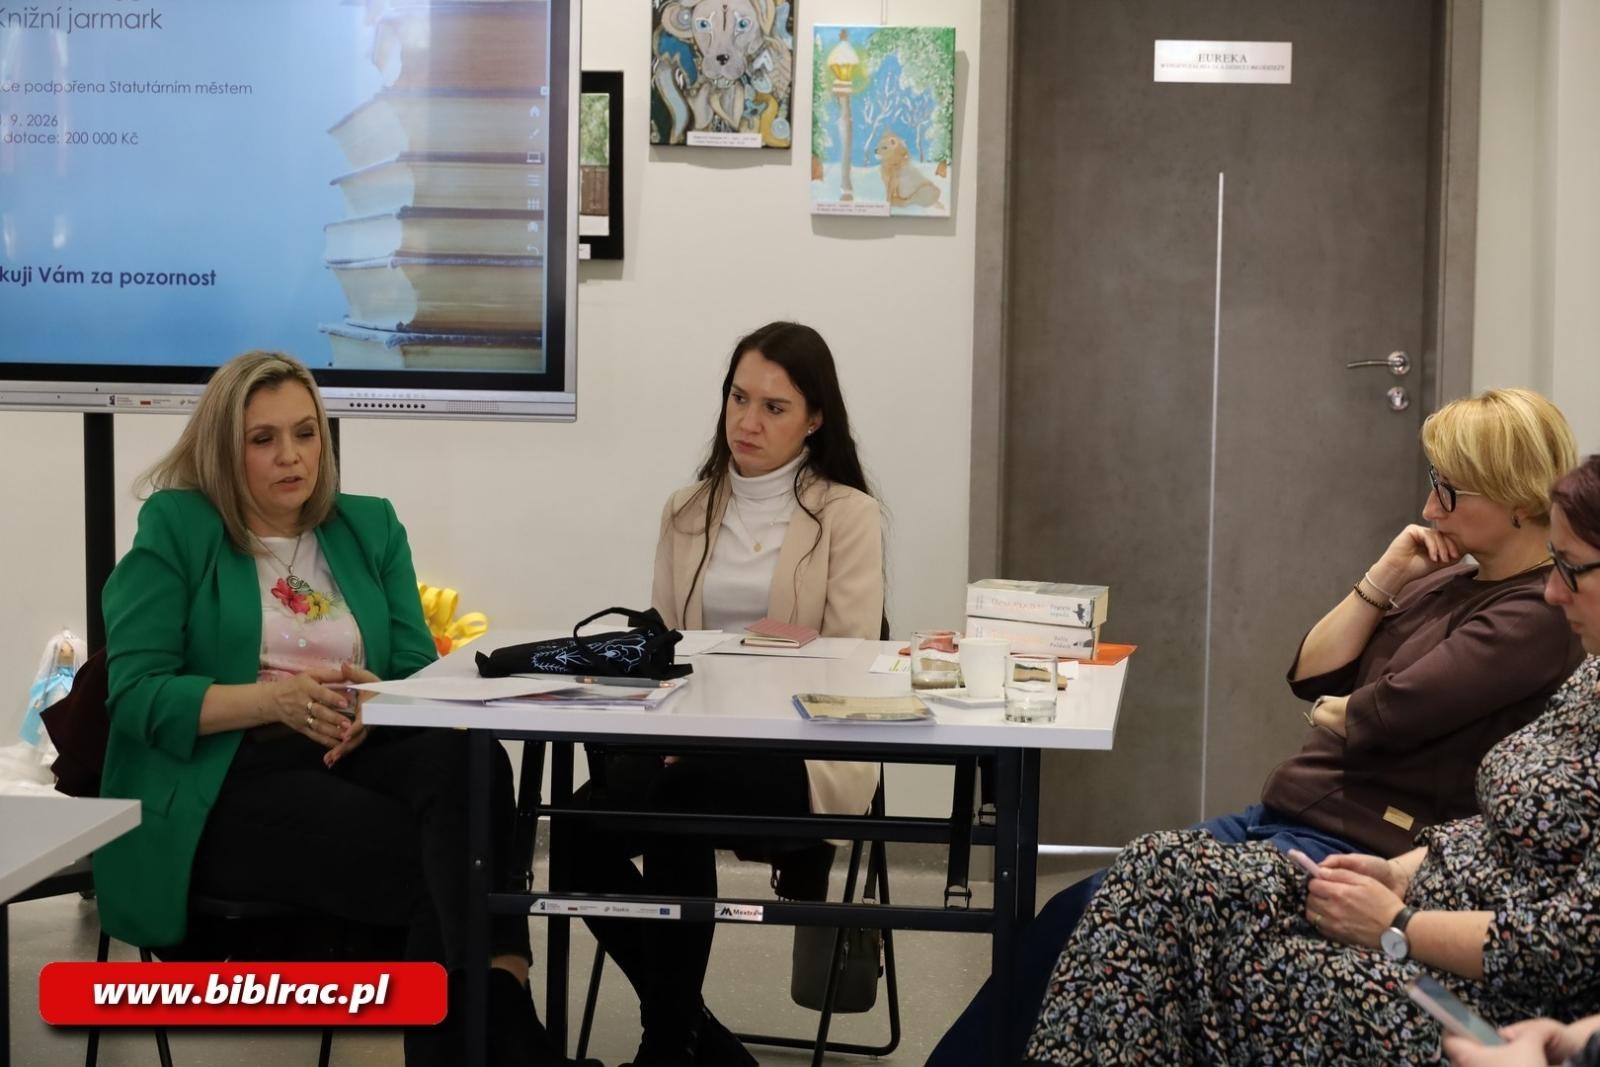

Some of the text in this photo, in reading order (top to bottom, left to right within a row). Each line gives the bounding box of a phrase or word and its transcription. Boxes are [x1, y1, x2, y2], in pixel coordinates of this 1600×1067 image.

[67, 8, 163, 34] jarmark
[1198, 53, 1248, 64] EUREKA
[24, 80, 106, 95] podpořena
[109, 80, 192, 94] Statutárním
[195, 81, 253, 95] městem
[26, 113, 59, 127] 2026
[3, 131, 139, 145] dotace: 200 000 Kč
[39, 264, 84, 284] Vám
[91, 270, 114, 285] za
[120, 269, 217, 288] pozornost
